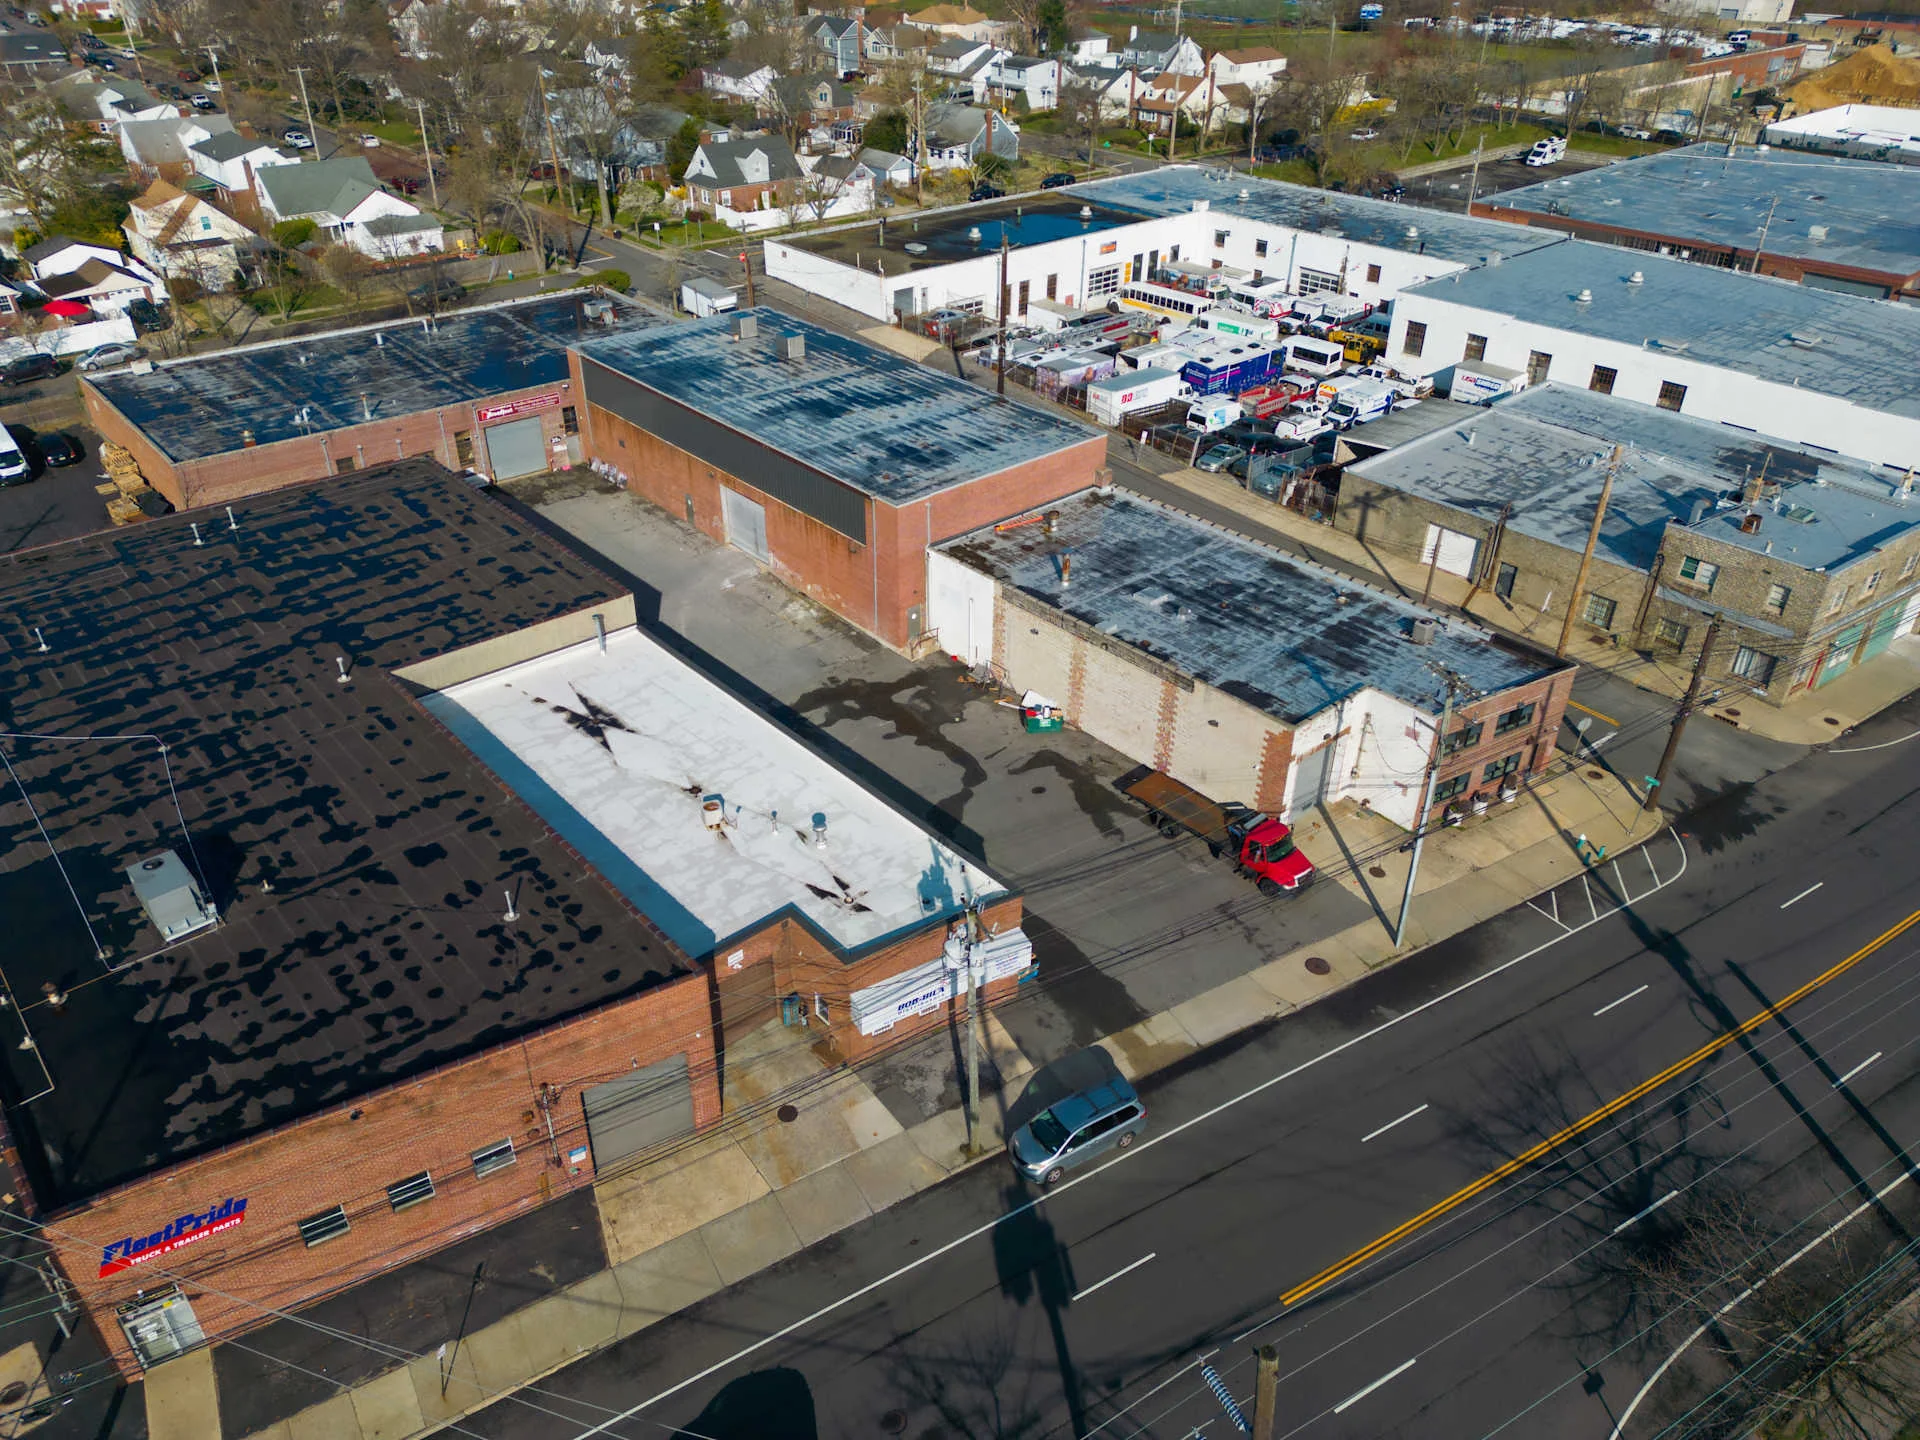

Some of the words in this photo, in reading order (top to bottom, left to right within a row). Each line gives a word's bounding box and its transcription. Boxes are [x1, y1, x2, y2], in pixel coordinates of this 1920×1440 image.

[101, 1197, 248, 1267] FleetPride
[130, 1248, 161, 1266] TRUCK
[173, 1230, 210, 1250] TRAILER
[212, 1218, 241, 1233] PARTS
